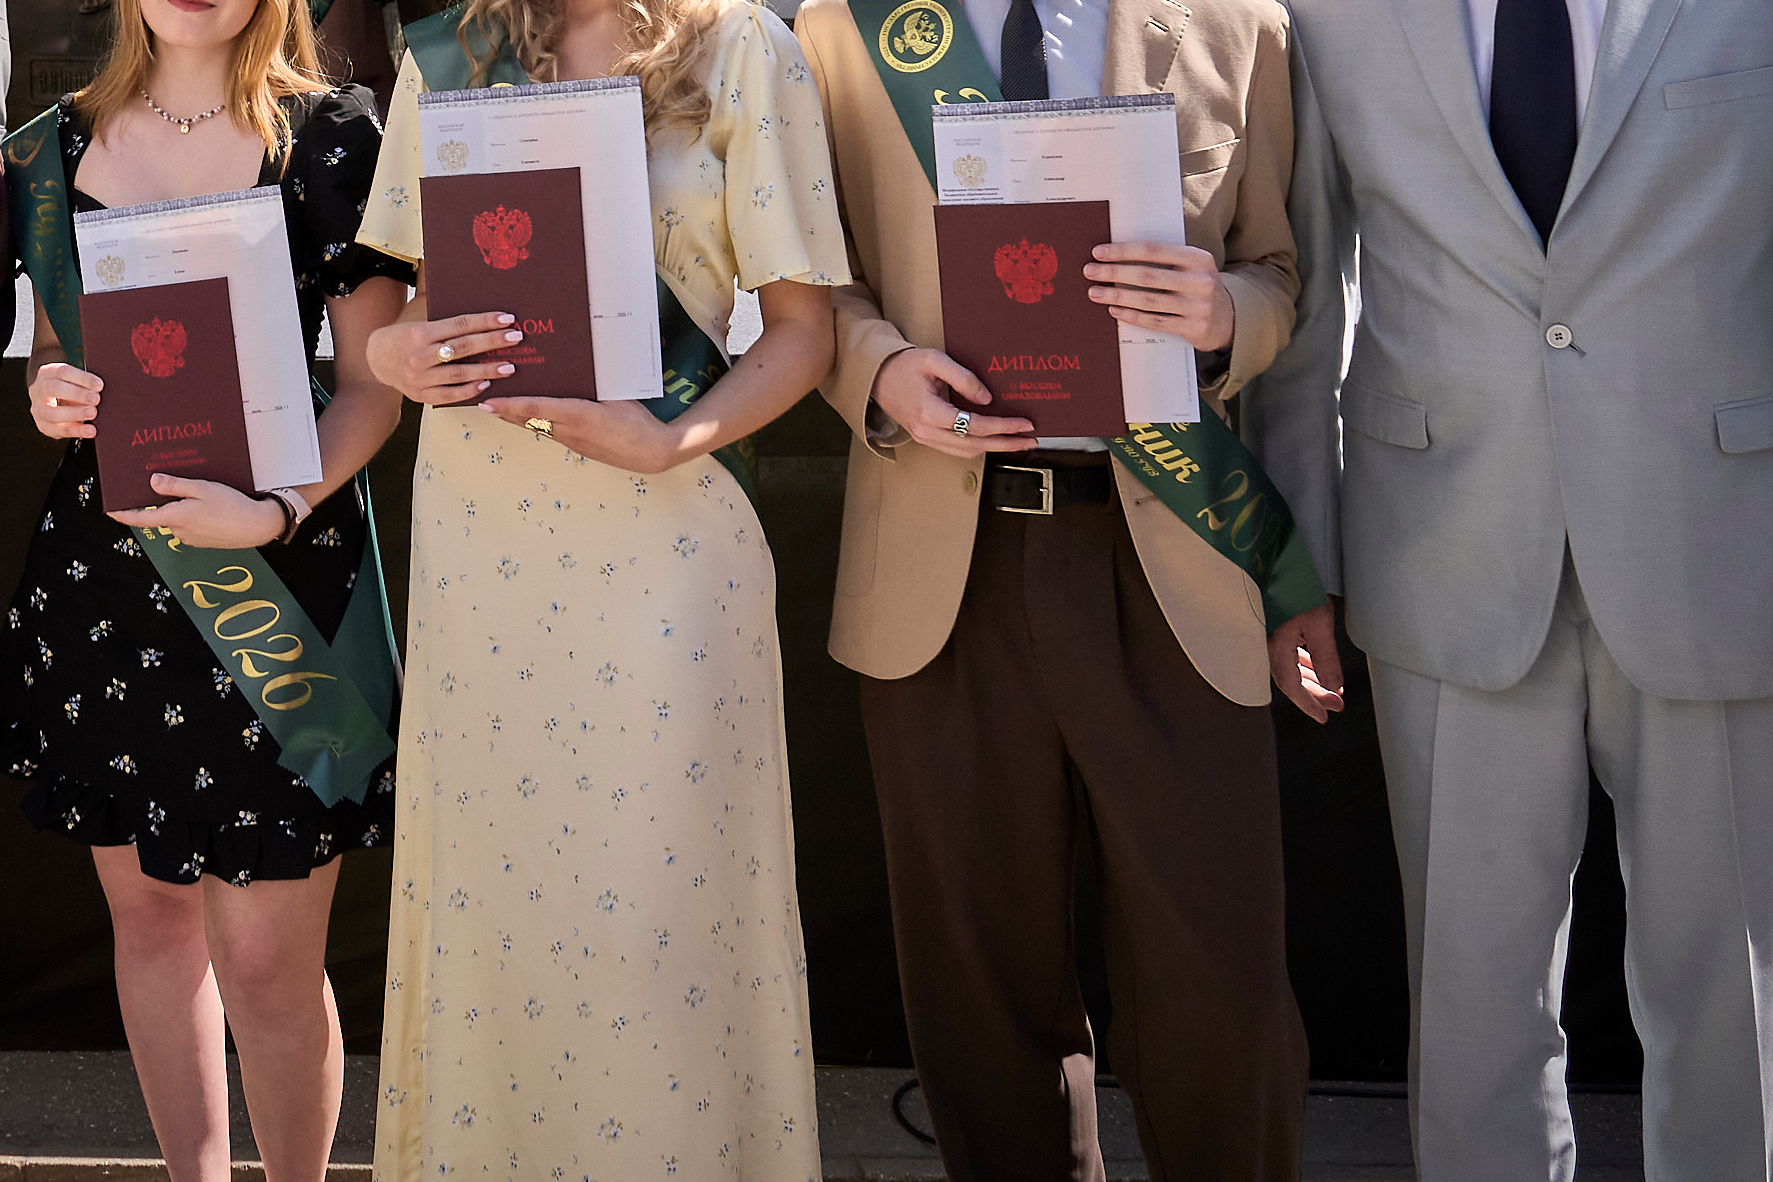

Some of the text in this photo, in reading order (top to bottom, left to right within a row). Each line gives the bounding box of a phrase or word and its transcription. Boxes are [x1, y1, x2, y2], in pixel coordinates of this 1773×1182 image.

[987, 355, 1081, 373] ДИПЛОМ
[131, 421, 213, 446] ДИПЛОМ
[183, 565, 337, 711] 2026
